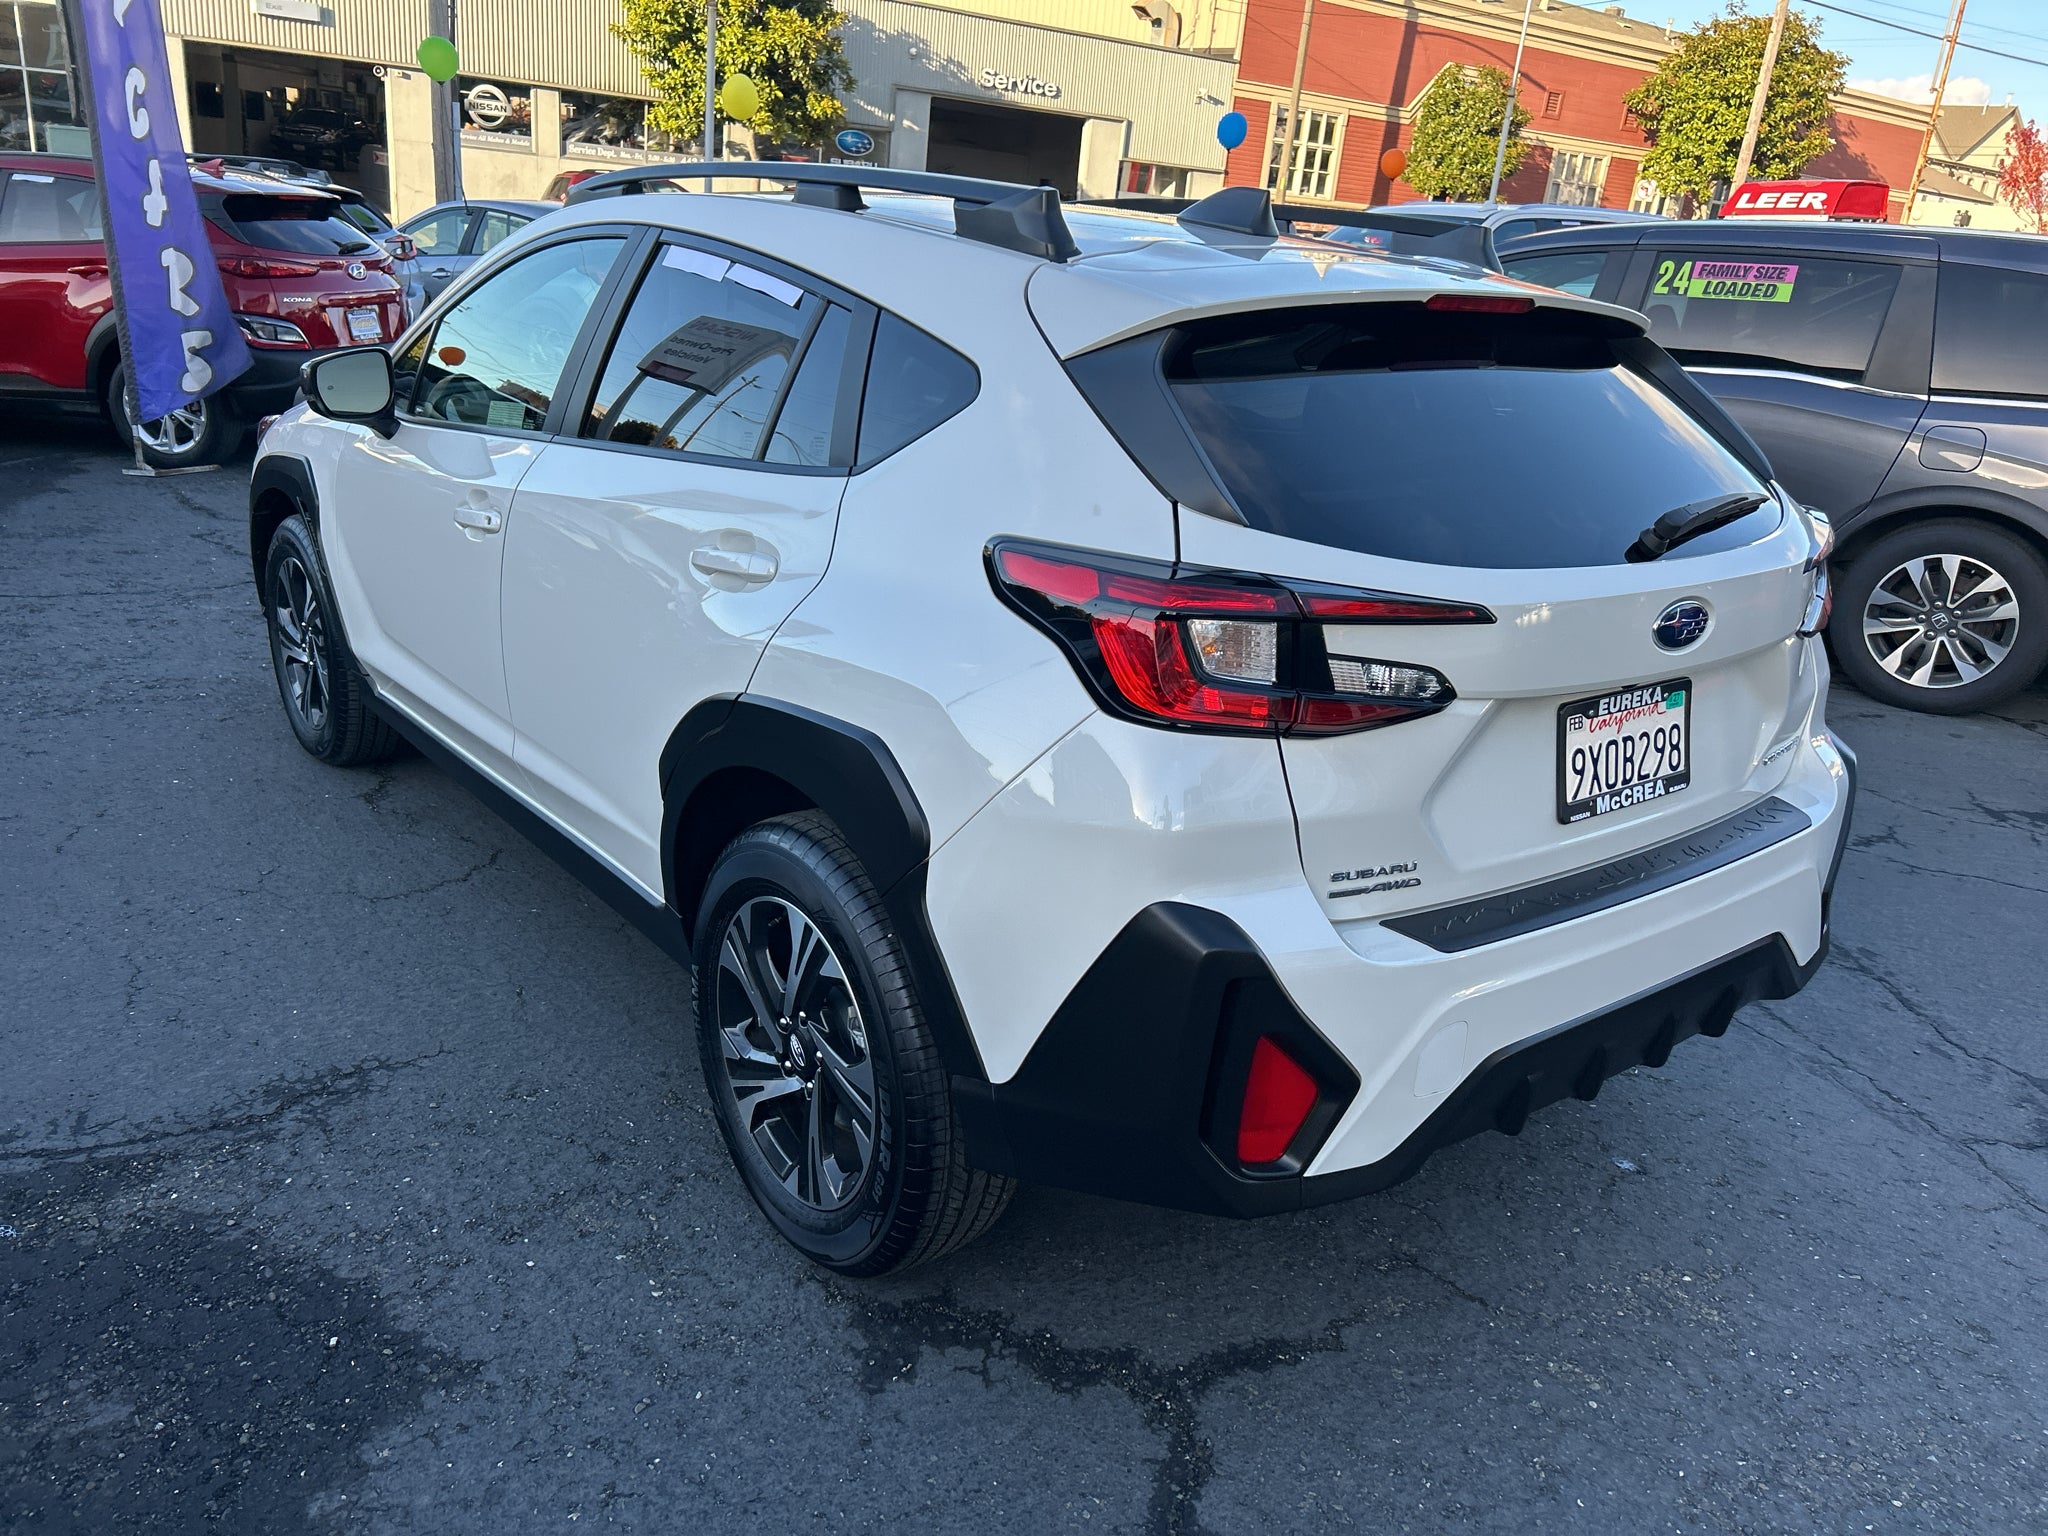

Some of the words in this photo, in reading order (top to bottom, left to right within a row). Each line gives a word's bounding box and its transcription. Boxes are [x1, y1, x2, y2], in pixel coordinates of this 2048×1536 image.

[980, 67, 1059, 97] Service
[468, 101, 508, 113] NISSAN
[568, 143, 597, 156] Service
[1735, 192, 1828, 210] LEER
[1653, 260, 1693, 295] 24
[1698, 263, 1753, 280] FAMILY
[1753, 266, 1790, 281] SIZE
[1702, 280, 1780, 301] LOADED
[1598, 687, 1661, 715] EUREKA
[1569, 715, 1585, 732] FEB
[1597, 780, 1664, 814] McCREA
[1570, 811, 1591, 822] NISSAN
[1330, 861, 1417, 882] SUBARU
[1366, 878, 1421, 893] AWD
